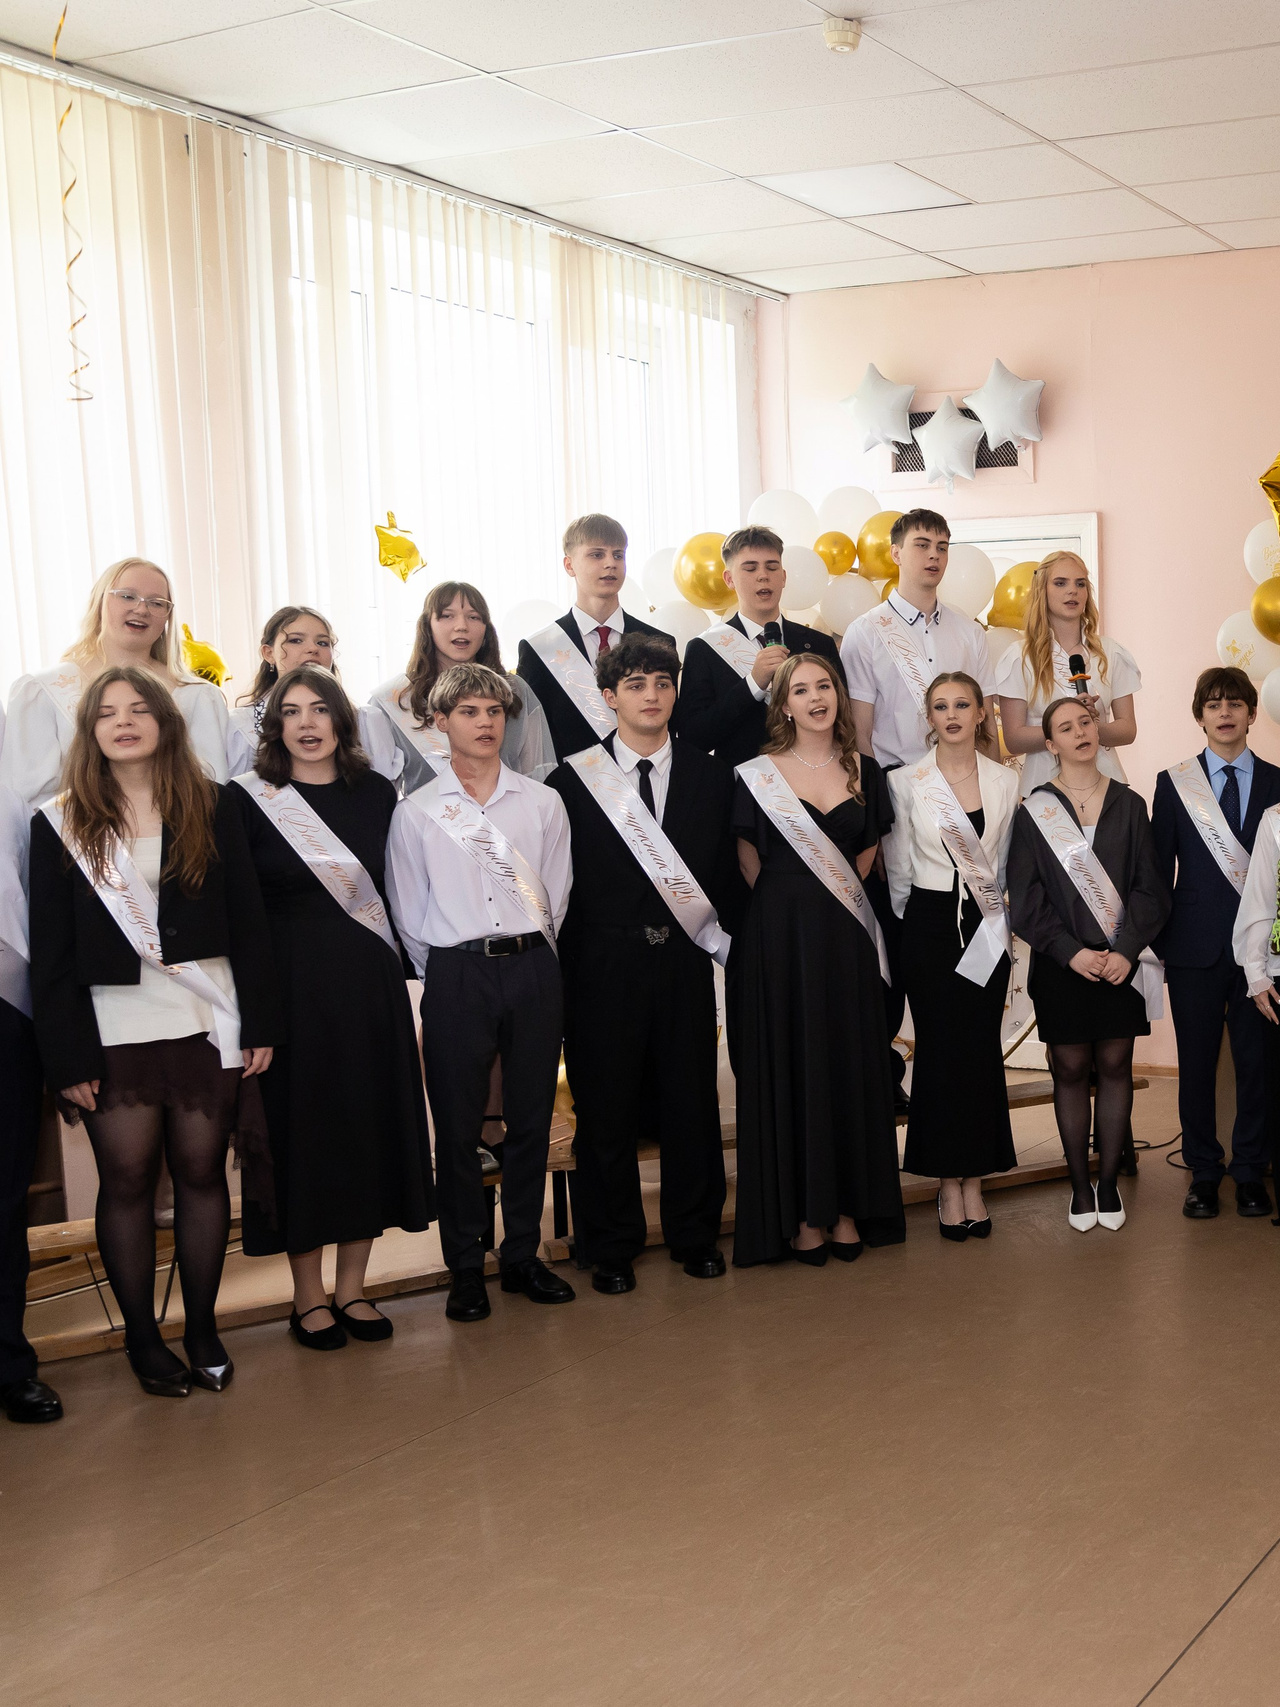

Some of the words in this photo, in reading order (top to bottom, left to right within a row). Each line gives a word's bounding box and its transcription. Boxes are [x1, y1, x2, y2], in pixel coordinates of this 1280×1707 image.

[925, 787, 985, 881] Выпускница
[977, 883, 1004, 911] 2026
[661, 874, 700, 905] 2026
